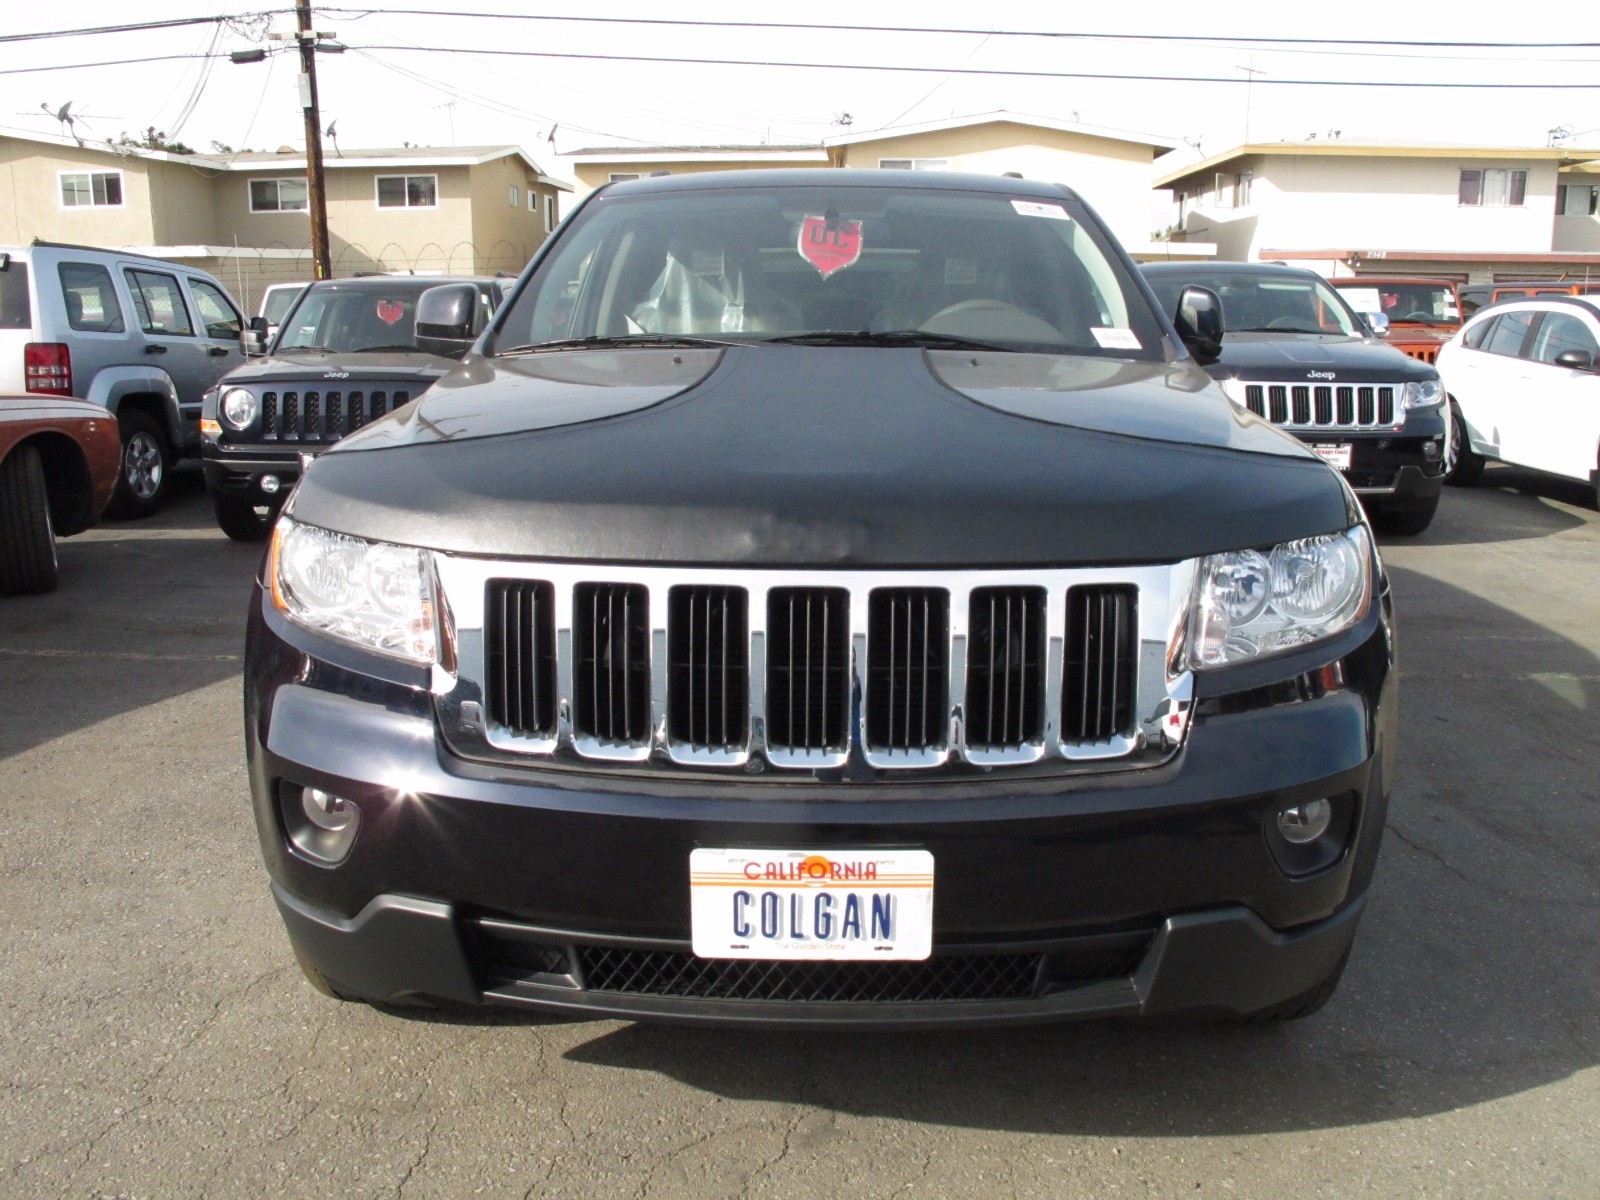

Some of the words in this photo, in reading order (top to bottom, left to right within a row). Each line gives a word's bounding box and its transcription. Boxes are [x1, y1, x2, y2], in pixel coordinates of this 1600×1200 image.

[1307, 370, 1336, 381] Jeep
[743, 861, 877, 880] CALIFORNIA
[733, 890, 895, 940] COLGAN
[776, 942, 789, 950] The
[792, 942, 823, 950] Golden
[825, 942, 847, 950] State
